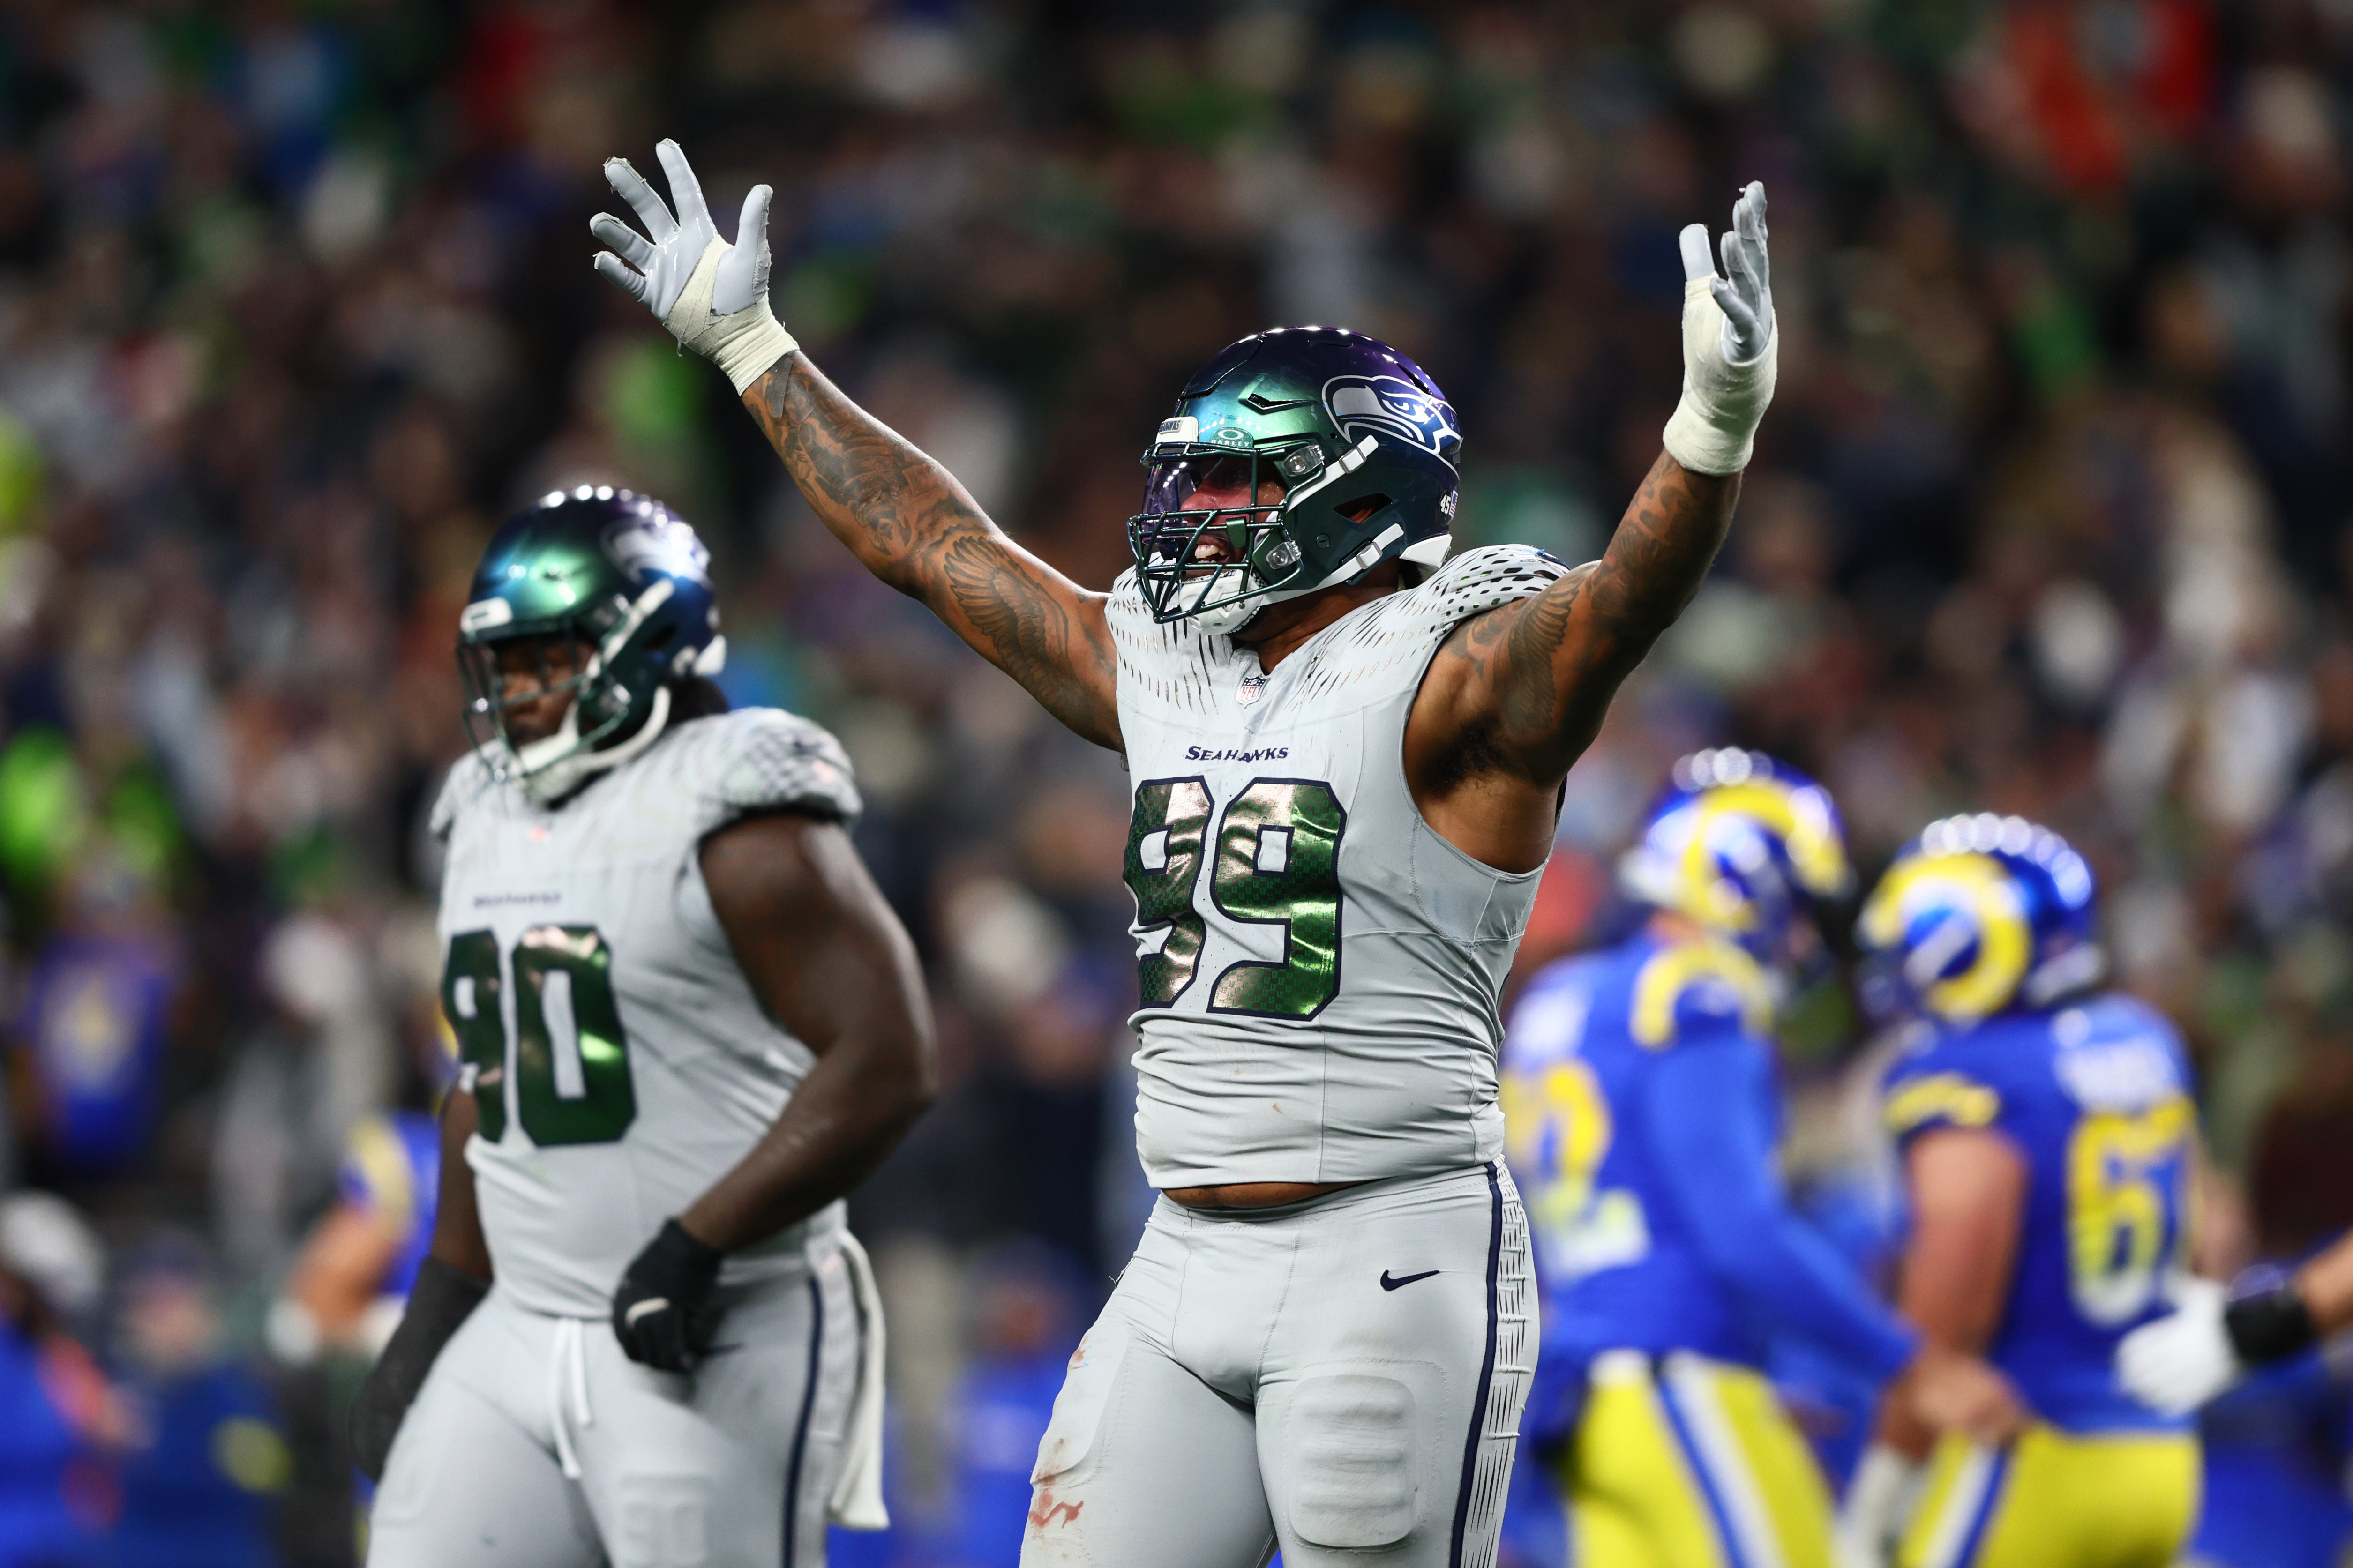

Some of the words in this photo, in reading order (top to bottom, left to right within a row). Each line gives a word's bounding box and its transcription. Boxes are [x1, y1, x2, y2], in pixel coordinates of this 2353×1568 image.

[1440, 494, 1451, 514] 45
[1240, 687, 1257, 700] NFL
[1123, 776, 1347, 1022] 99
[442, 923, 638, 1147] 90
